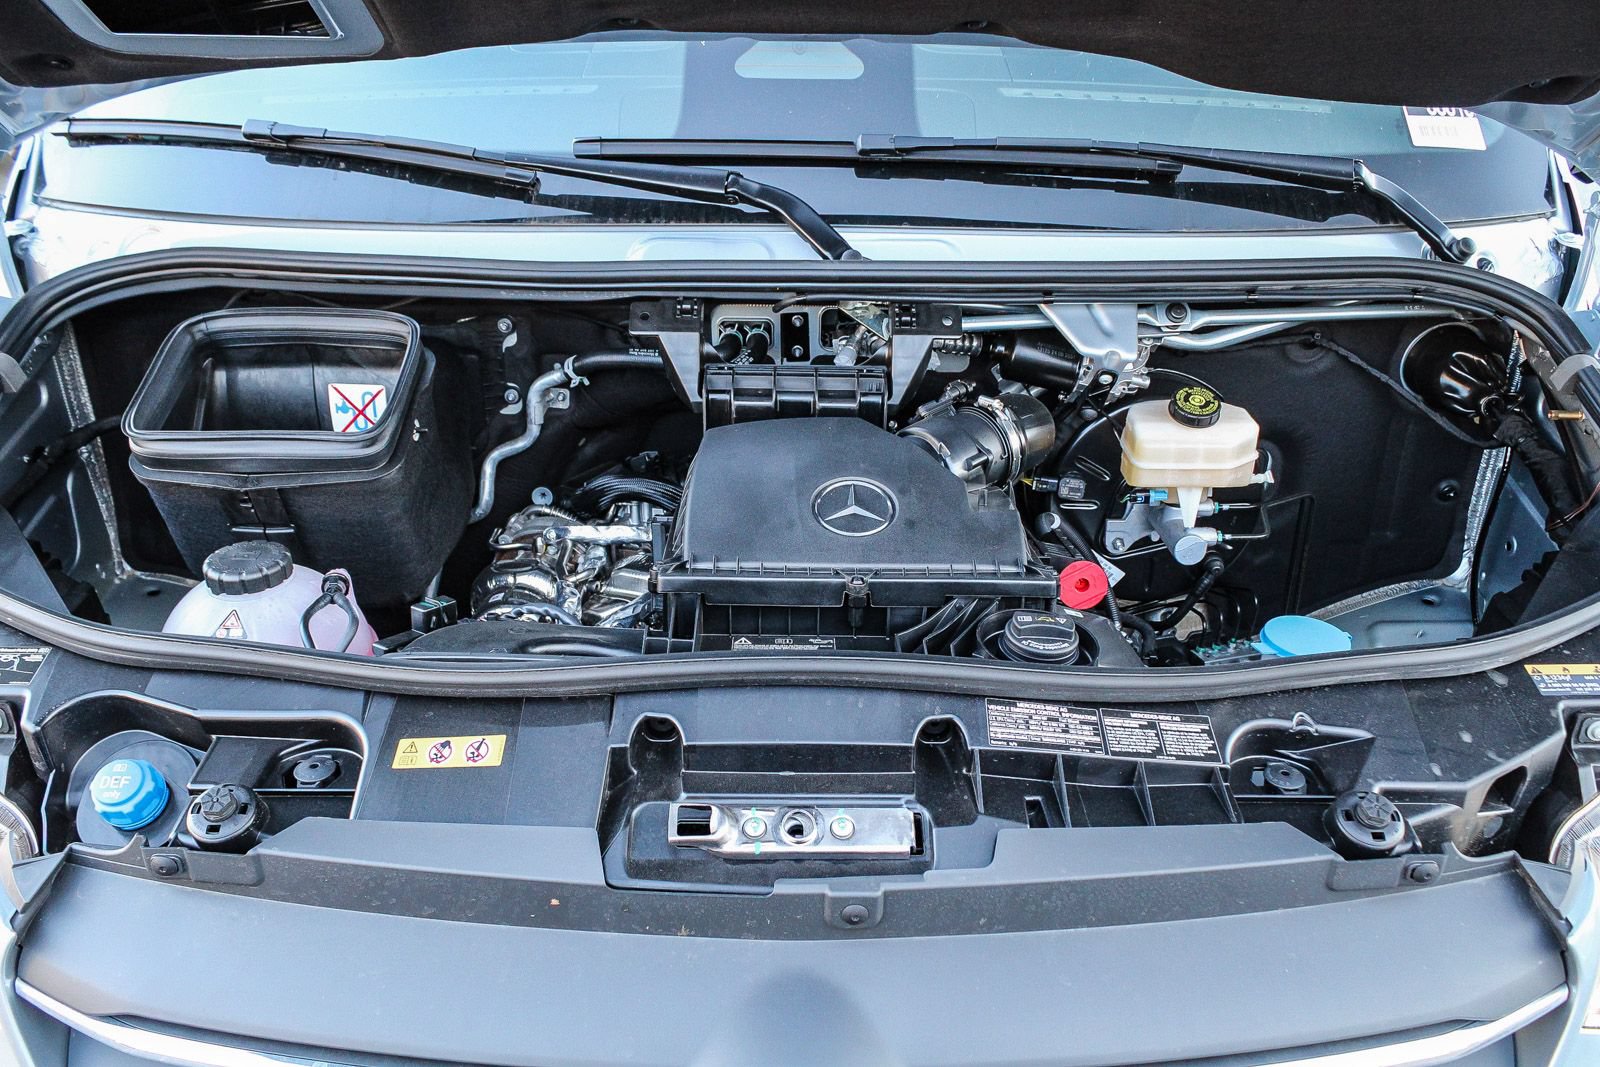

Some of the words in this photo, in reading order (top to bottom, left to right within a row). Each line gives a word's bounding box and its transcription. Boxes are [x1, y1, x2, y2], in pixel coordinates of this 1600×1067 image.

[1037, 709, 1060, 717] CONTROL
[1061, 712, 1098, 720] INFORMATION
[100, 775, 132, 788] DEF
[103, 790, 121, 799] only
